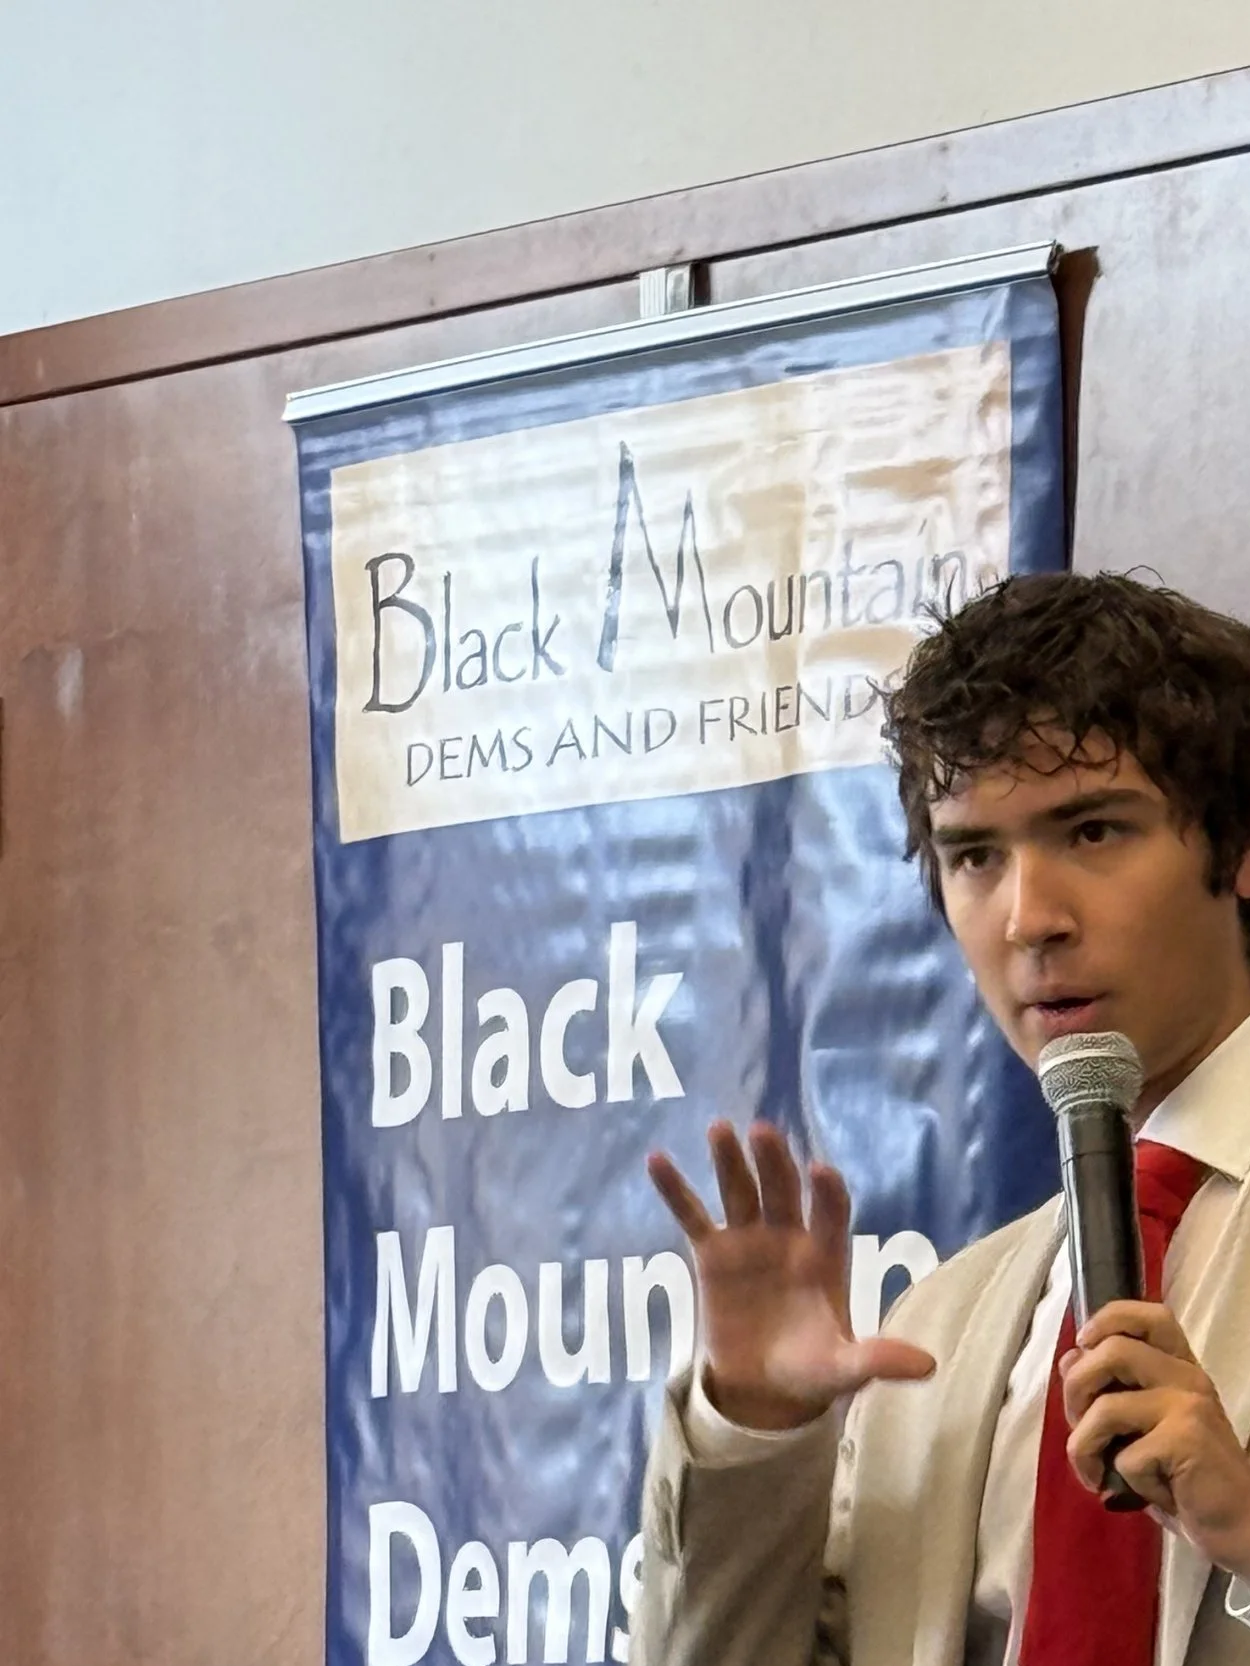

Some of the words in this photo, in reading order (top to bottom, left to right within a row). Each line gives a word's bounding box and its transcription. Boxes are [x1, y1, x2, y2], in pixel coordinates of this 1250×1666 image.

[363, 552, 567, 713] Black
[597, 440, 968, 672] Mountain
[406, 726, 534, 787] DEMS
[547, 707, 677, 765] AND
[700, 670, 902, 744] FRIEND
[371, 921, 685, 1128] Black
[370, 1226, 940, 1399] Mounn
